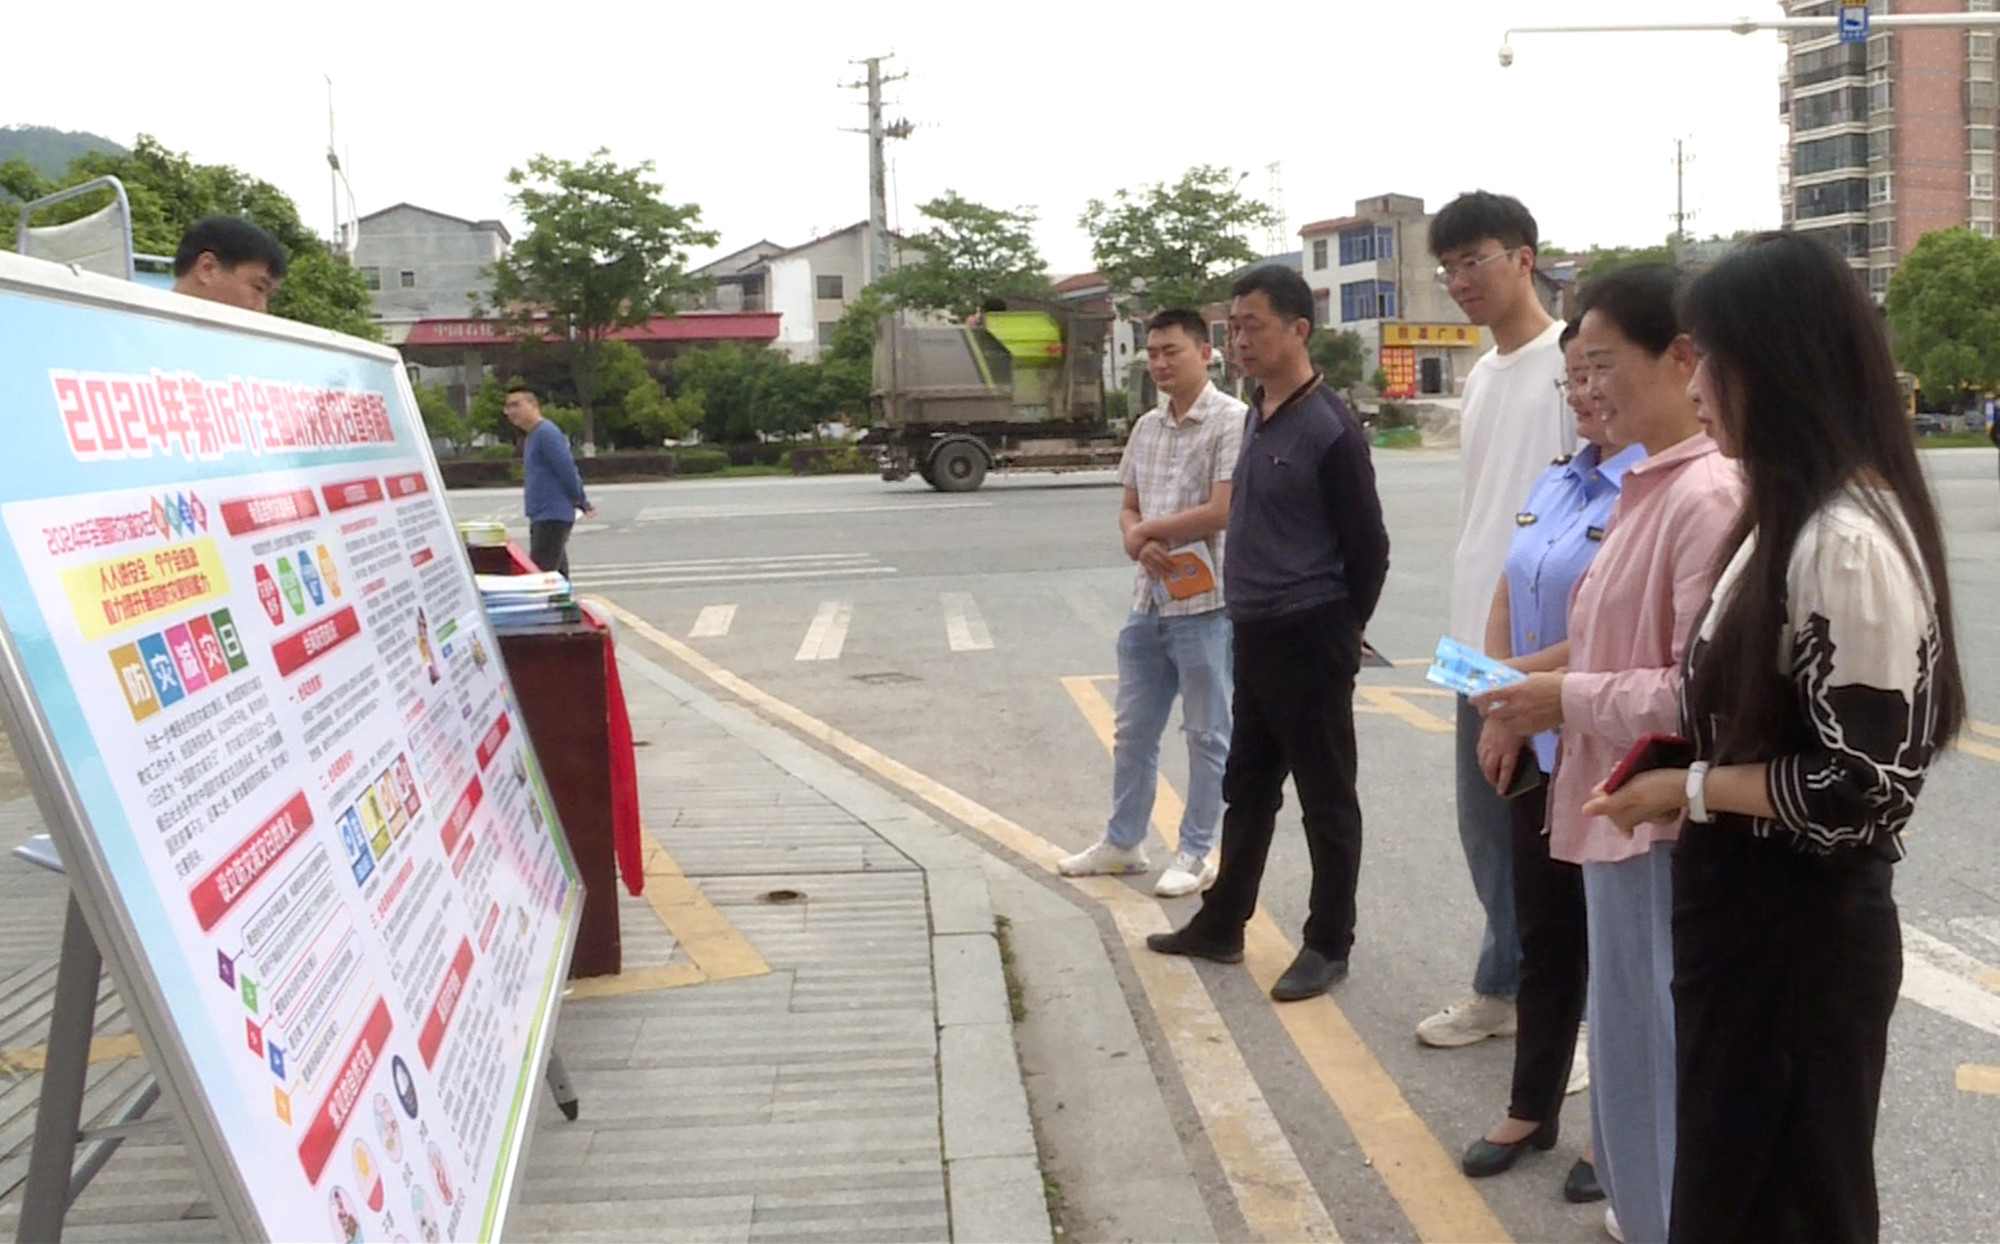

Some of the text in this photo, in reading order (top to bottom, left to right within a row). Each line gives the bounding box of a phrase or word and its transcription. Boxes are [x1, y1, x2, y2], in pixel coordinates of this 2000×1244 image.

[121, 623, 241, 706] 防灾减灾日
